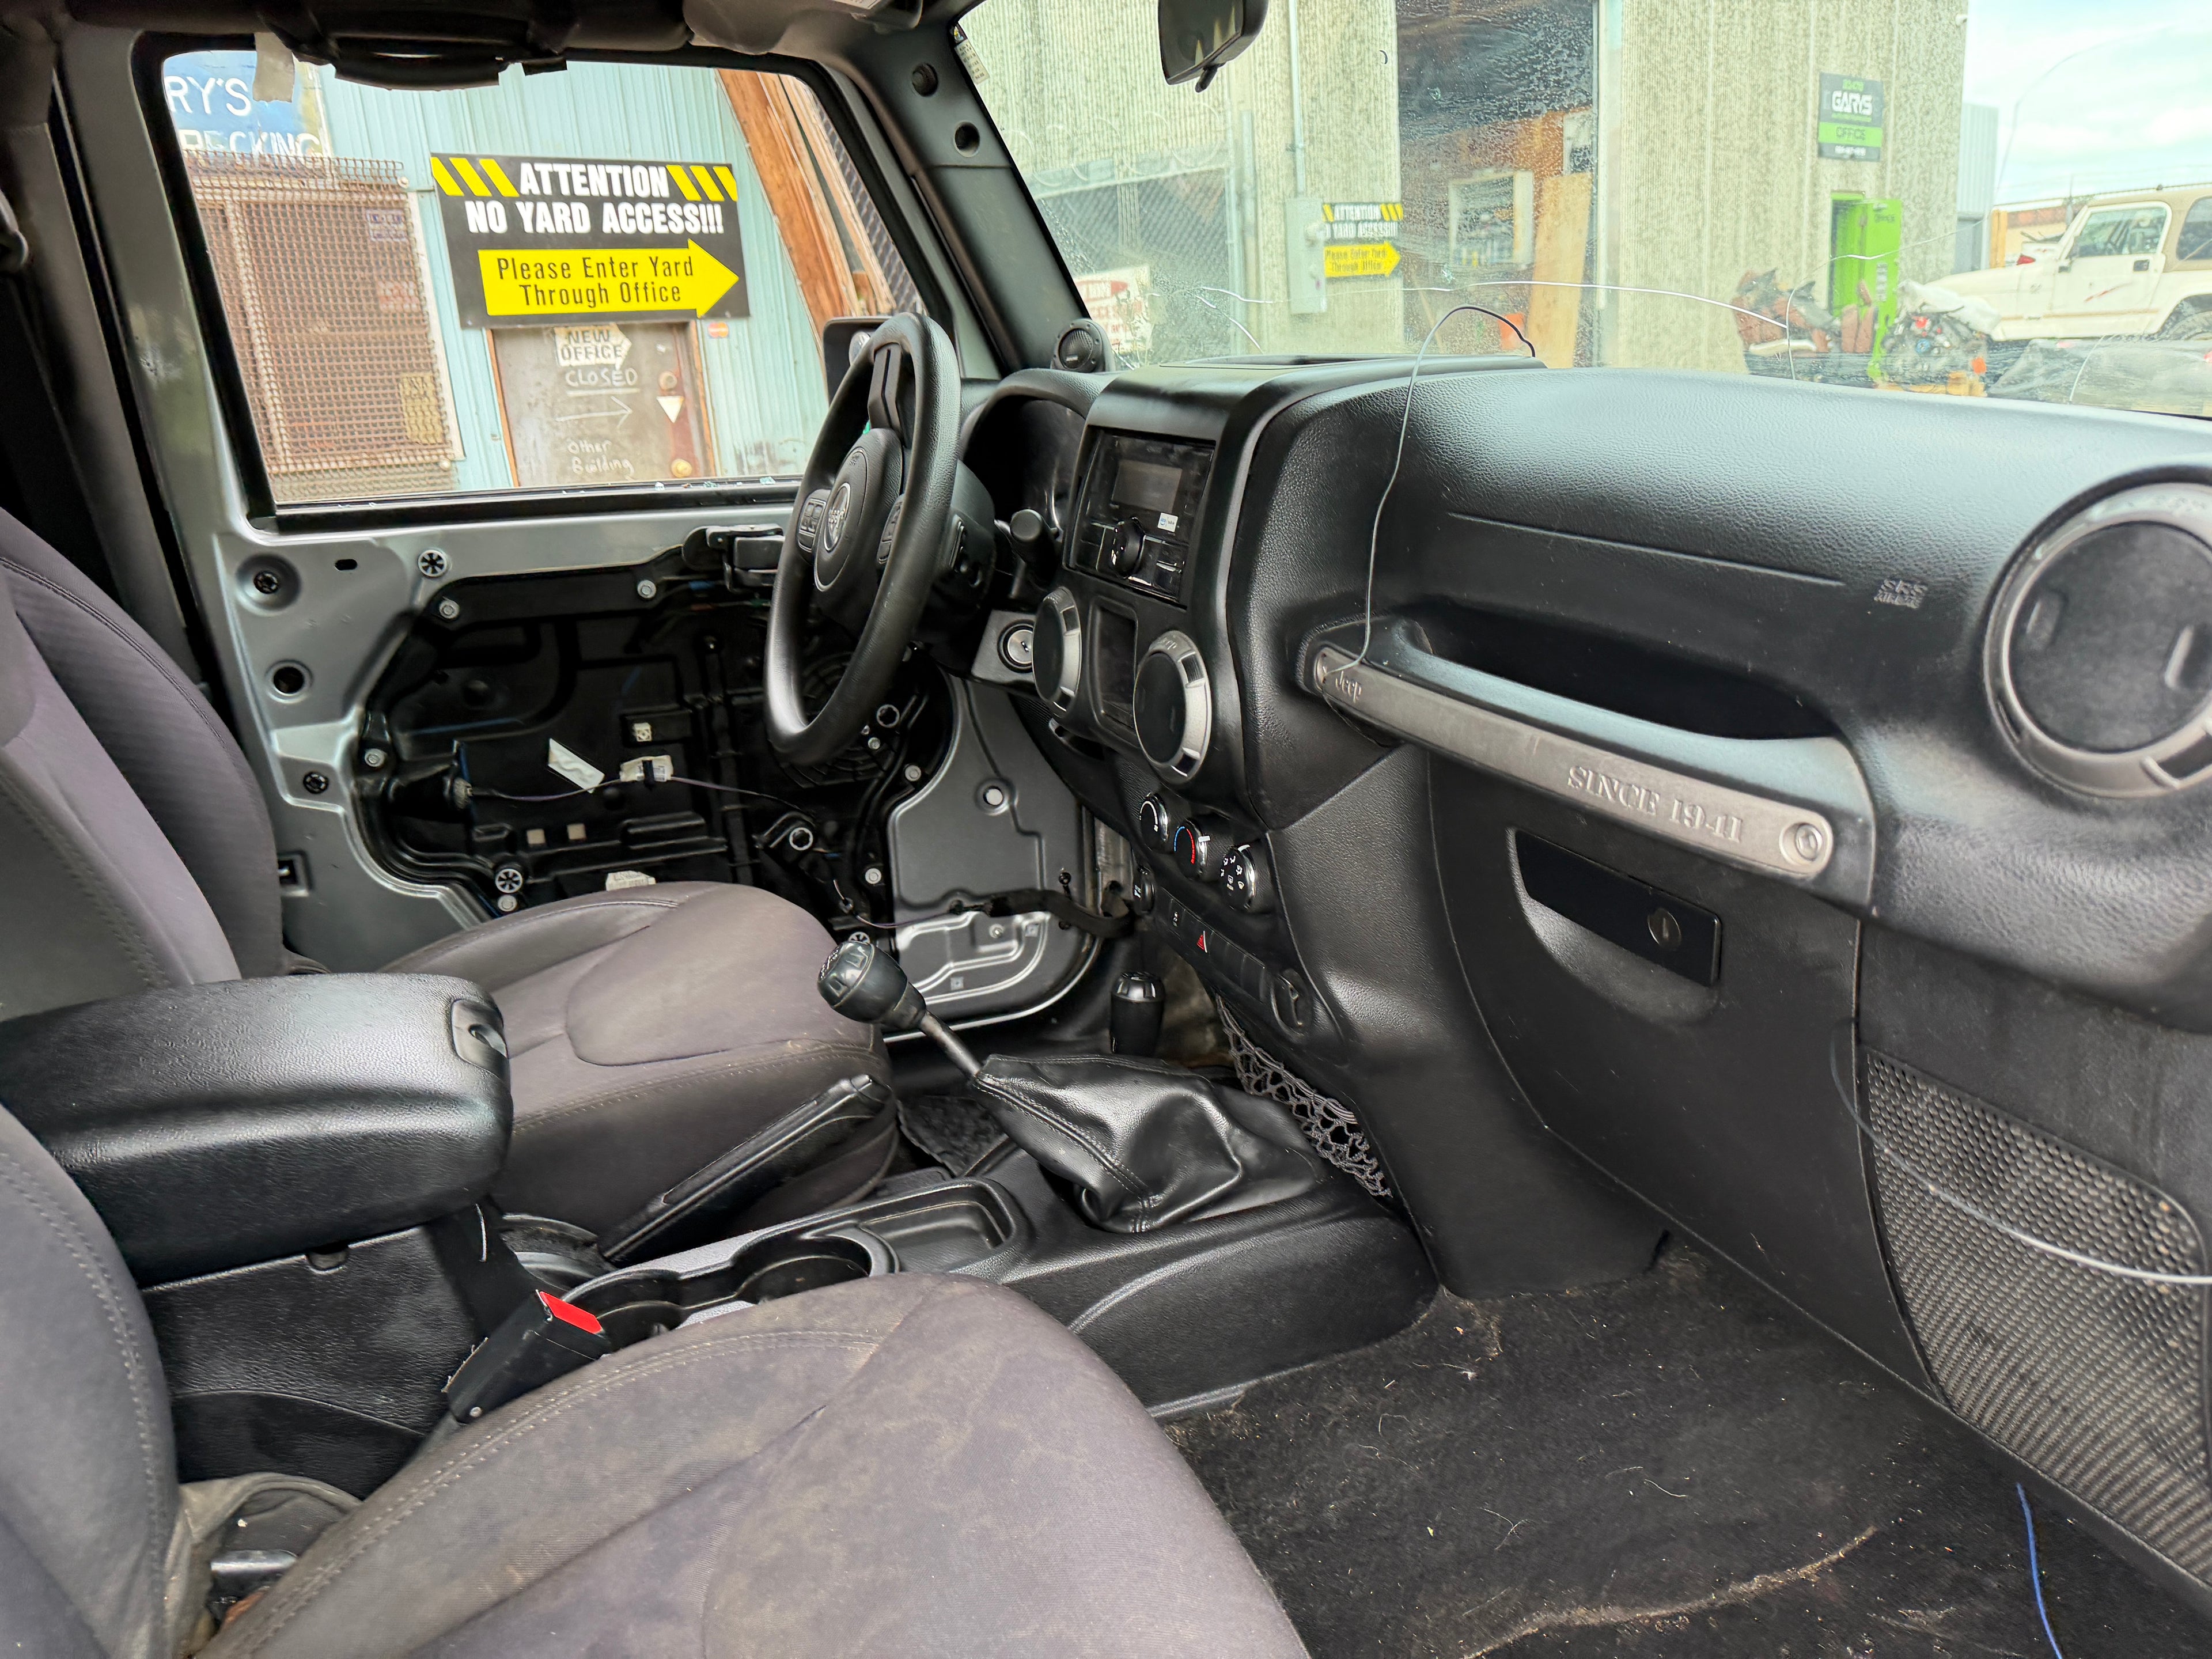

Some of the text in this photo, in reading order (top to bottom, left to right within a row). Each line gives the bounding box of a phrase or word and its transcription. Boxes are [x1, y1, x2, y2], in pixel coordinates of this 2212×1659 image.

[164, 75, 251, 116] RY'S
[520, 162, 671, 198] ATTENTION
[465, 200, 724, 234] NO YARD ACCESS!!!
[498, 256, 694, 279] Please Enter Yard
[519, 282, 681, 308] Through Office
[567, 330, 611, 344] NEW
[560, 344, 623, 361] OFFICE
[565, 367, 638, 387] CLOSED
[1335, 670, 1362, 702] Jeep
[1567, 766, 1743, 843] SINCE 1941
